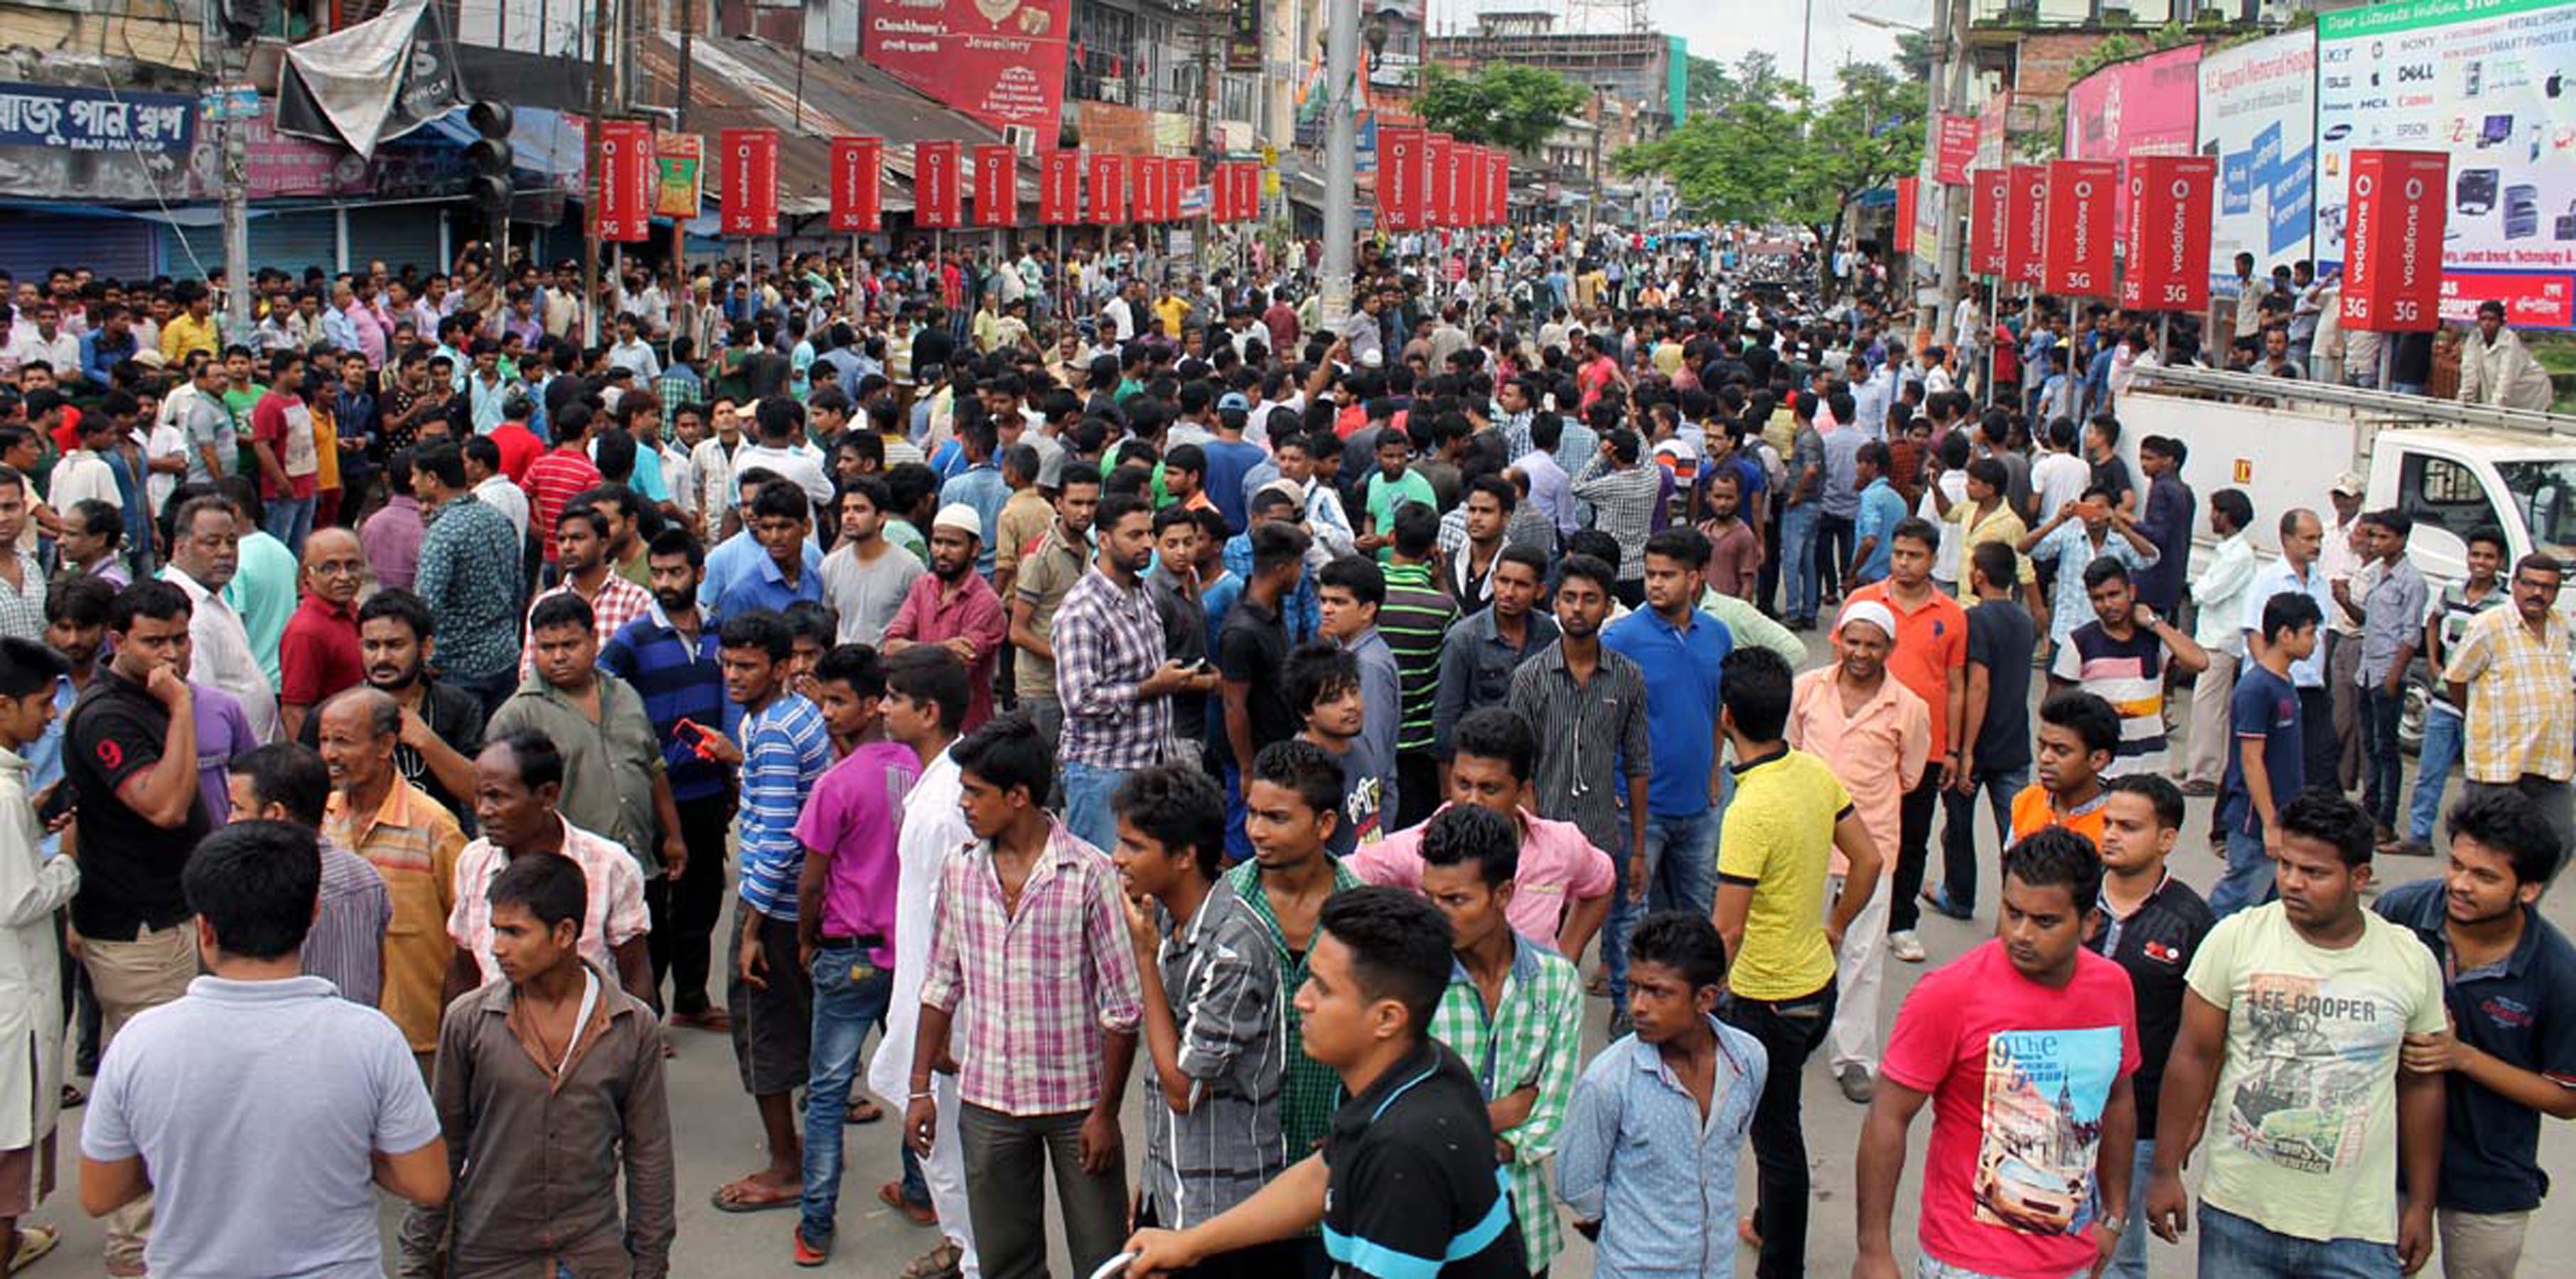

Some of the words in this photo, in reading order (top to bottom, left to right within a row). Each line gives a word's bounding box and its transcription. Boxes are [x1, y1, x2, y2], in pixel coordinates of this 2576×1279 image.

[965, 36, 1031, 54] Jewellery
[2400, 37, 2436, 50] SONY
[2398, 64, 2435, 82] DELL
[2359, 98, 2389, 109] HCL
[601, 220, 619, 235] 3G
[735, 216, 752, 229] 3G
[2075, 200, 2089, 263] vodafone
[2172, 201, 2186, 274] vodafone
[2354, 200, 2369, 284] vodafone
[2403, 204, 2419, 286] vodafone
[2065, 271, 2091, 289] 3G
[2164, 284, 2188, 303] 3G
[2344, 297, 2368, 318] 3G
[2393, 301, 2419, 322] 3G
[96, 739, 123, 769] 9
[2247, 988, 2285, 1011] LEE
[2295, 993, 2376, 1022] COOPER
[2013, 1035, 2058, 1057] The
